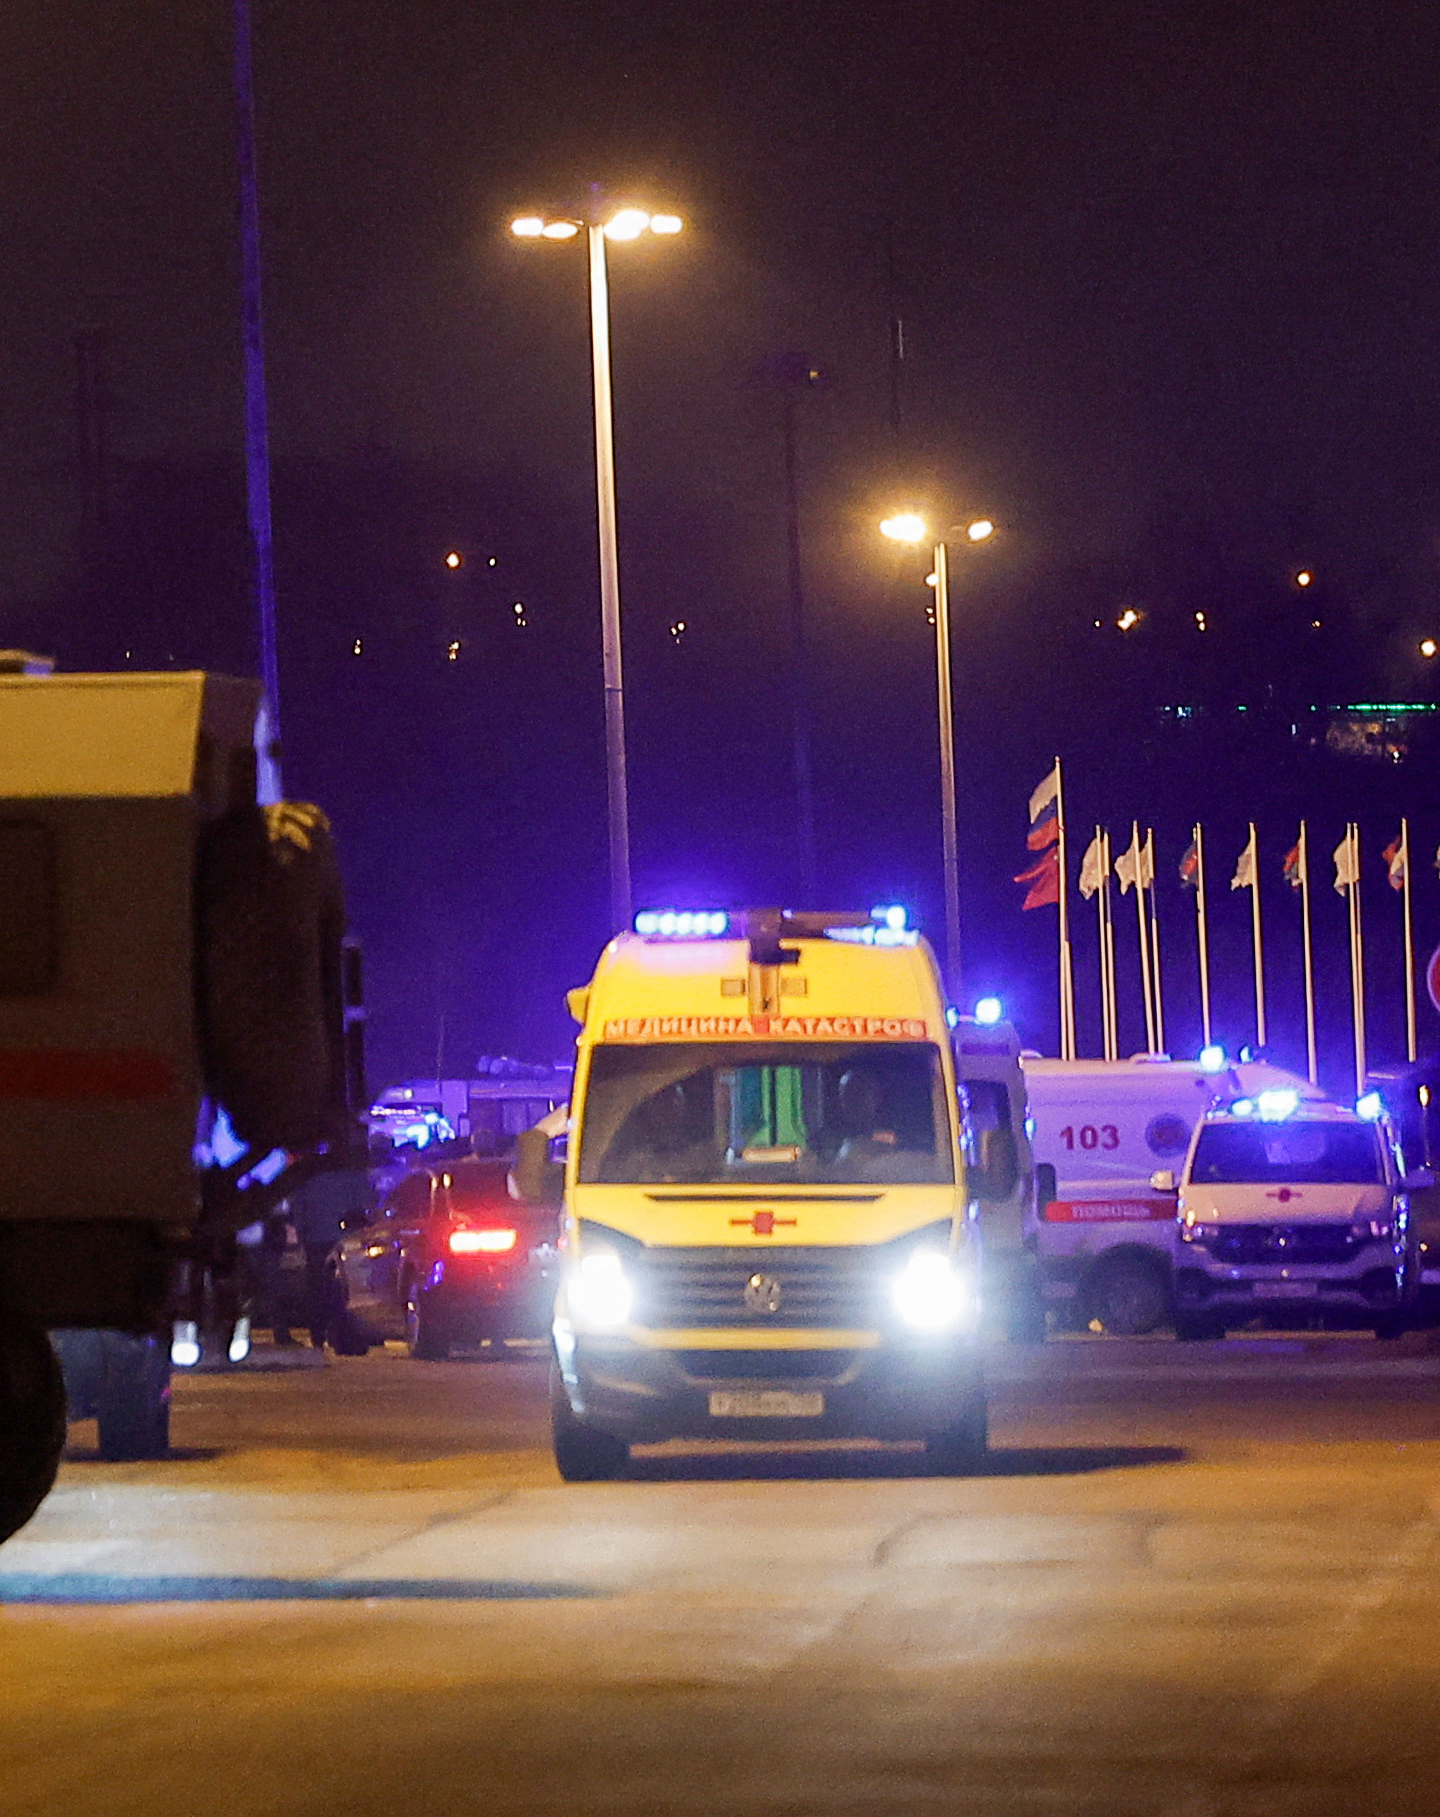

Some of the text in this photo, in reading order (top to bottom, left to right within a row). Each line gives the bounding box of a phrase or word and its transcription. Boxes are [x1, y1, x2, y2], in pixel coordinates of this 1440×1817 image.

[605, 1016, 925, 1038] МЕДИЦИНА КАТАСТРОФ
[1060, 1124, 1120, 1150] 103
